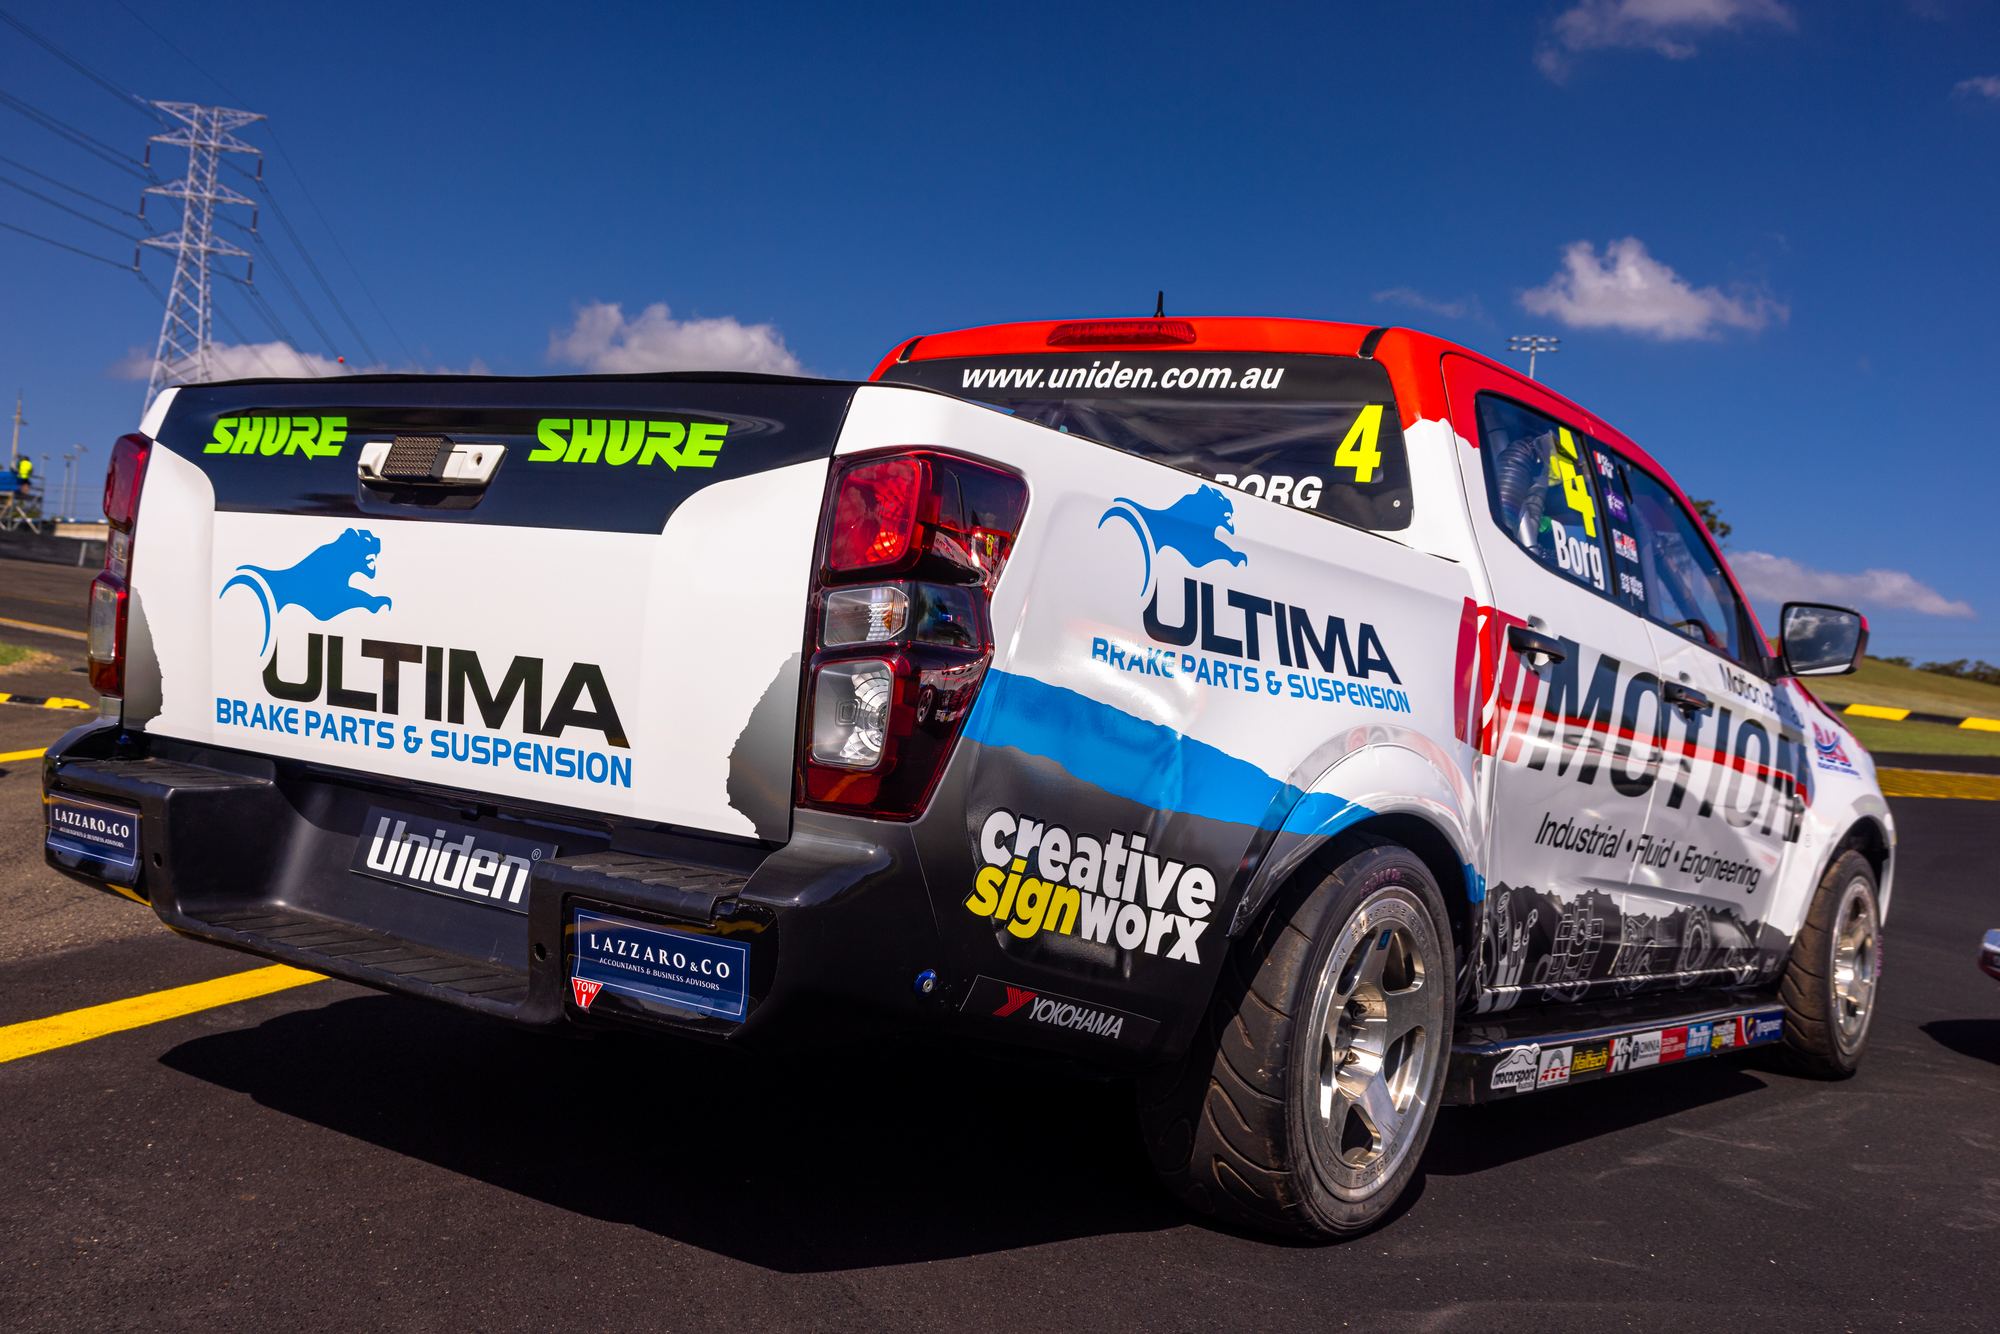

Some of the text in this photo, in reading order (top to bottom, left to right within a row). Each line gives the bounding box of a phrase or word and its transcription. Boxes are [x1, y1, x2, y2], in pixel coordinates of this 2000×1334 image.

[962, 361, 1285, 389] www.uniden.com.au
[203, 416, 348, 460] SHURE
[527, 418, 729, 472] SHURE
[1334, 405, 1384, 483] 4
[1558, 426, 1597, 538] 4
[1551, 519, 1605, 591] Borg
[1142, 577, 1402, 686] ULTIMA
[262, 632, 631, 749] ULTIMA
[1092, 637, 1412, 714] BRAKE PARTS & SUSPENSION
[216, 697, 632, 788] BRAKE PARTS & SUSPENSION
[1527, 635, 1818, 843] MOTION
[980, 810, 1217, 919] creative
[1534, 812, 1762, 894] Industrial Fluid Engineering
[965, 857, 1210, 965] signworx
[576, 980, 597, 993] TOW
[599, 957, 645, 974] ACCOUNTANTS
[652, 969, 684, 983] BUSINESS
[685, 977, 720, 991] ADVISORS
[1028, 996, 1124, 1040] YOKOHAMA
